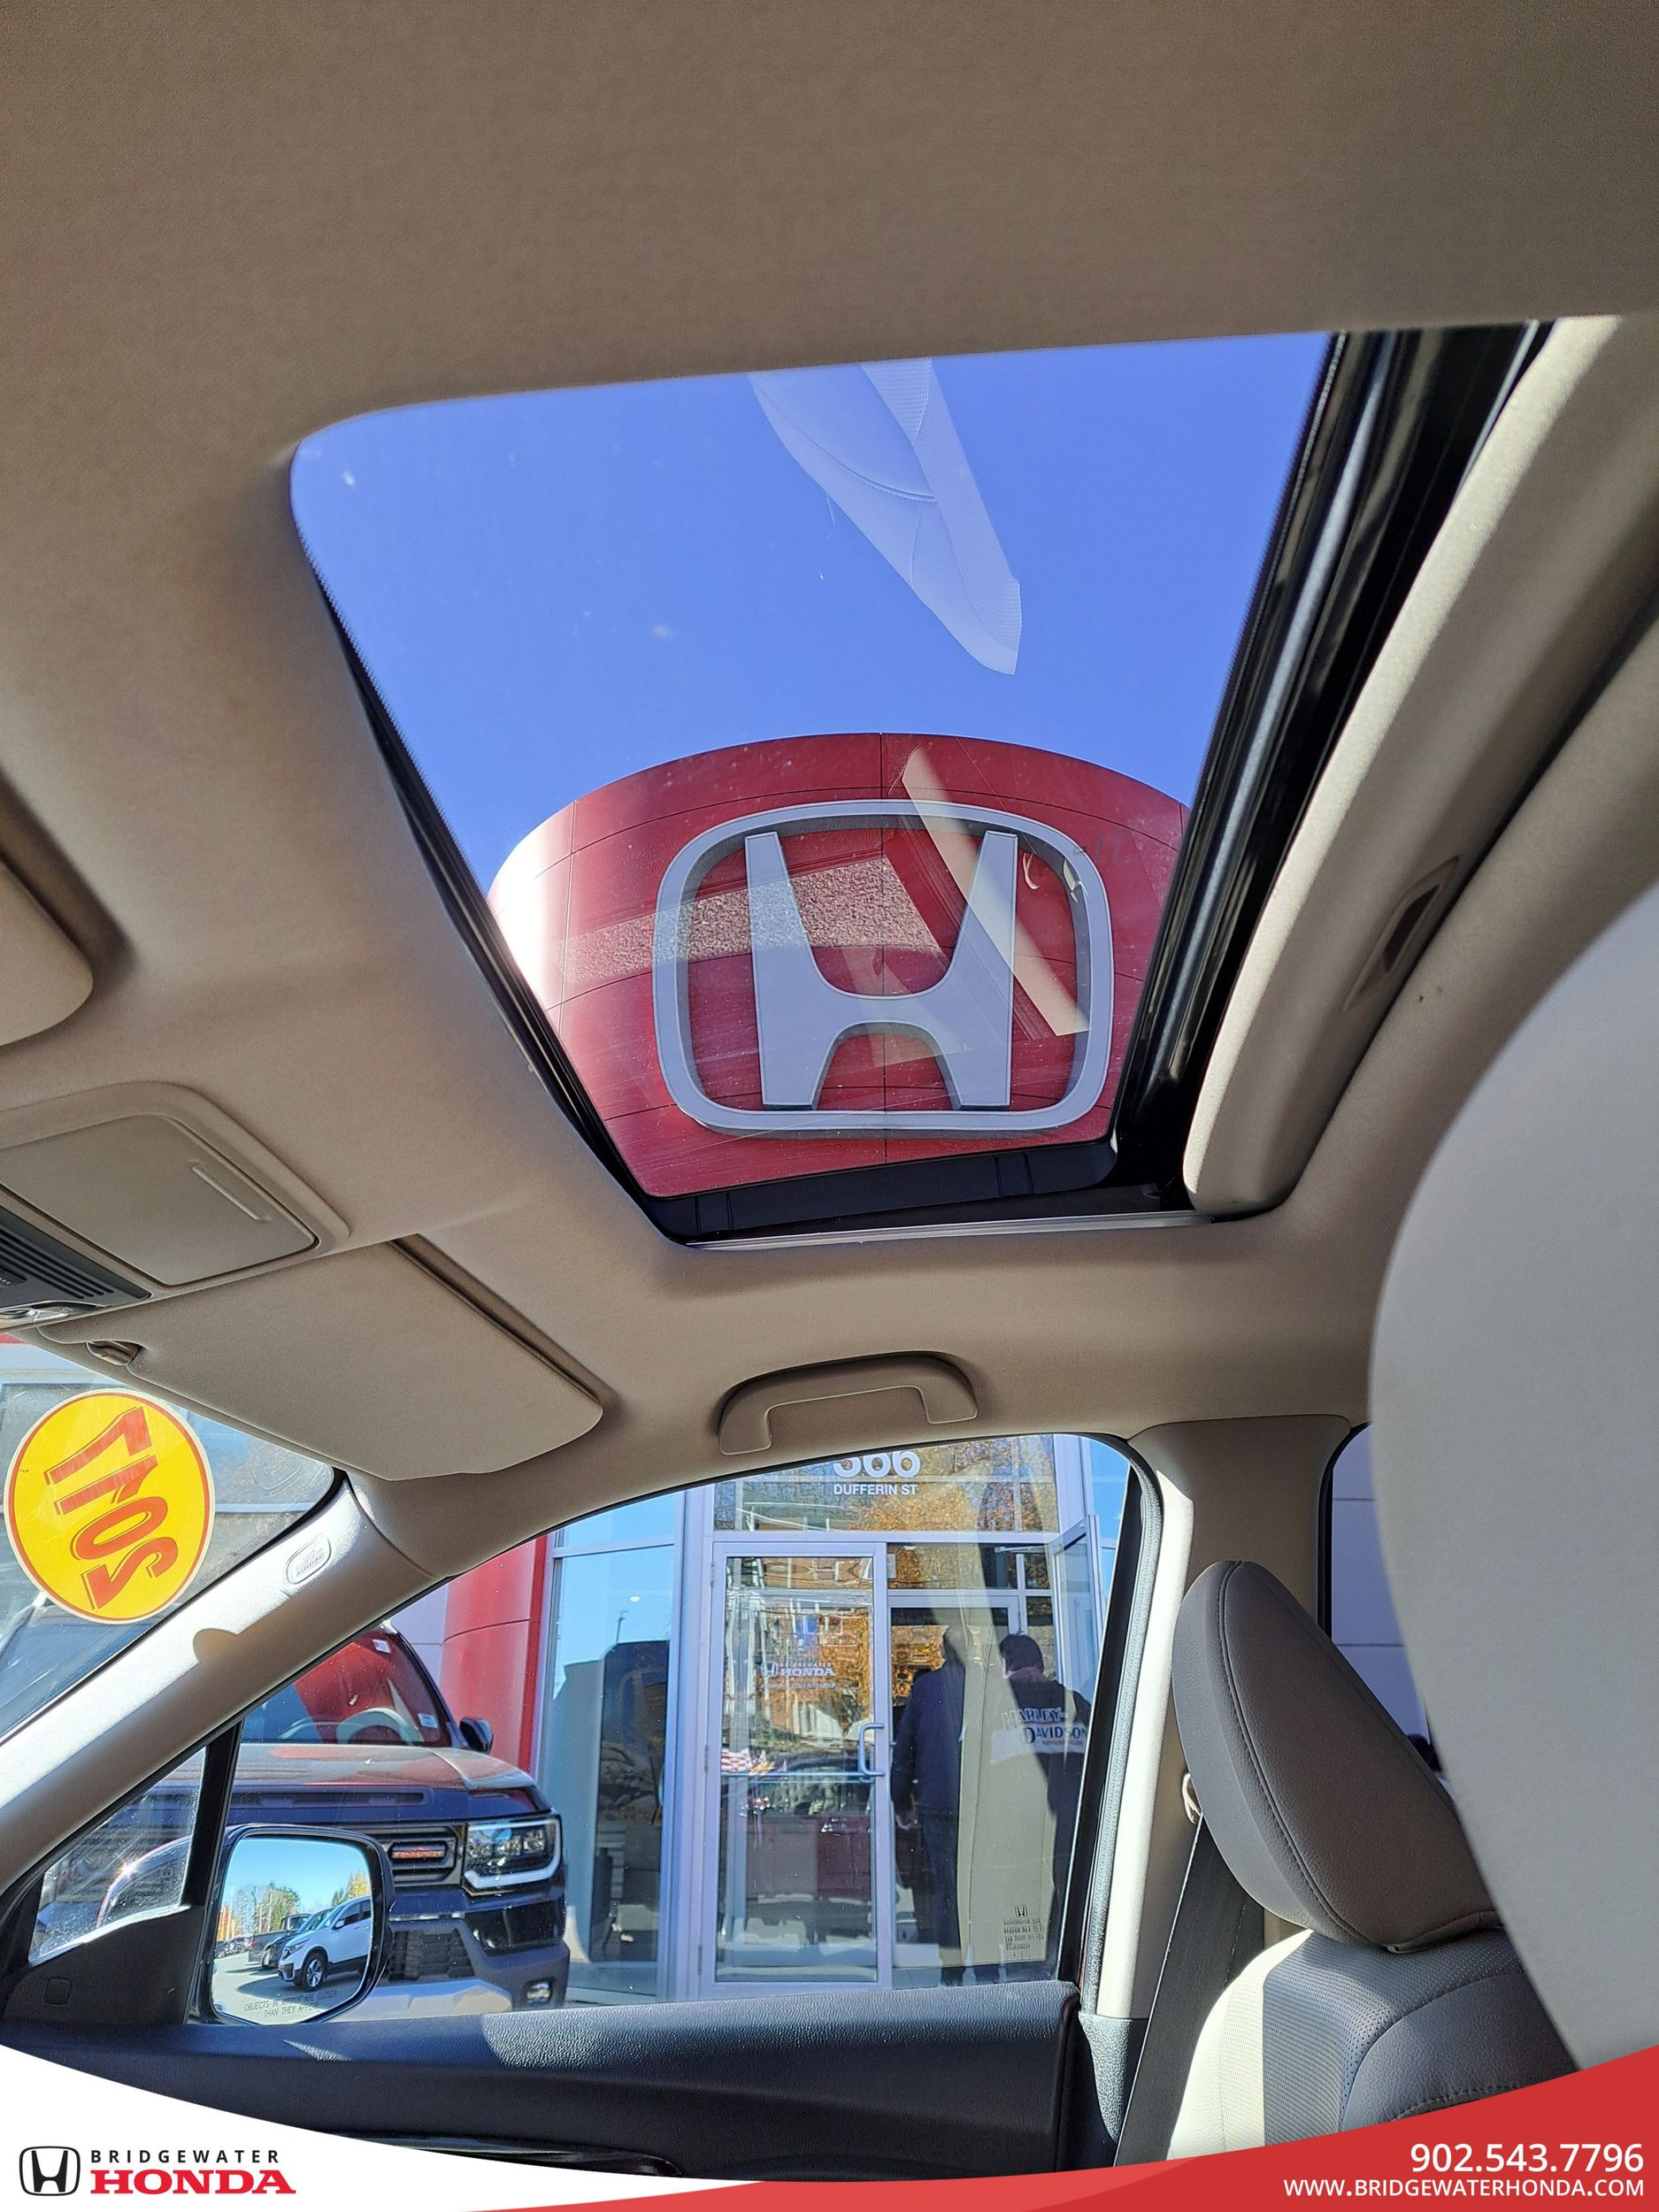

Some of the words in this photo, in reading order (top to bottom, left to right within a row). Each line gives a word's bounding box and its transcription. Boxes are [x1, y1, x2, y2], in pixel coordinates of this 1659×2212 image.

[833, 1484, 897, 1495] DUFFERIN
[901, 1484, 918, 1495] ST
[780, 1668, 836, 1677] HONDA
[243, 2000, 270, 2012] OBJECTS
[264, 2008, 279, 2018] THAN
[282, 2005, 296, 2015] THEY
